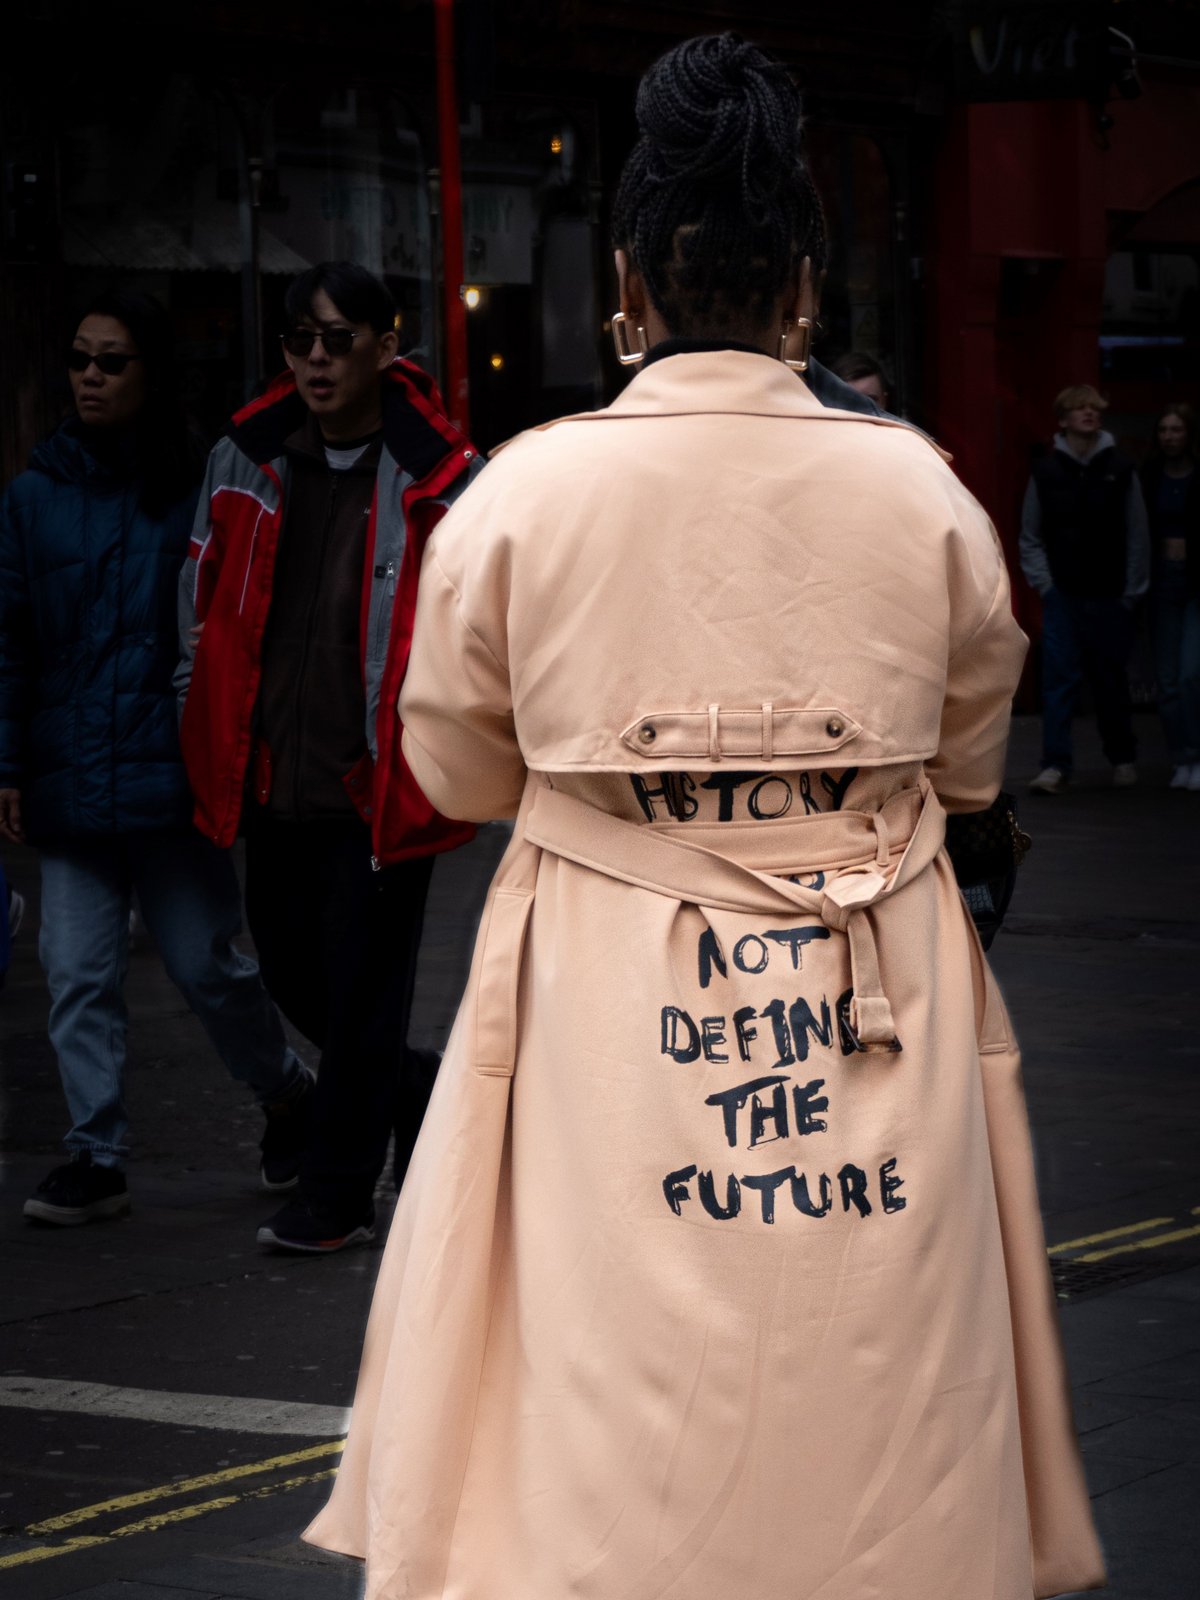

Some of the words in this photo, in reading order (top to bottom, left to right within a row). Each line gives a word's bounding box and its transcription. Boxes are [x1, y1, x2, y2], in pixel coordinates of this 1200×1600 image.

[698, 926, 831, 988] NOT
[704, 1075, 829, 1151] THE
[662, 1157, 907, 1224] FUTURE
